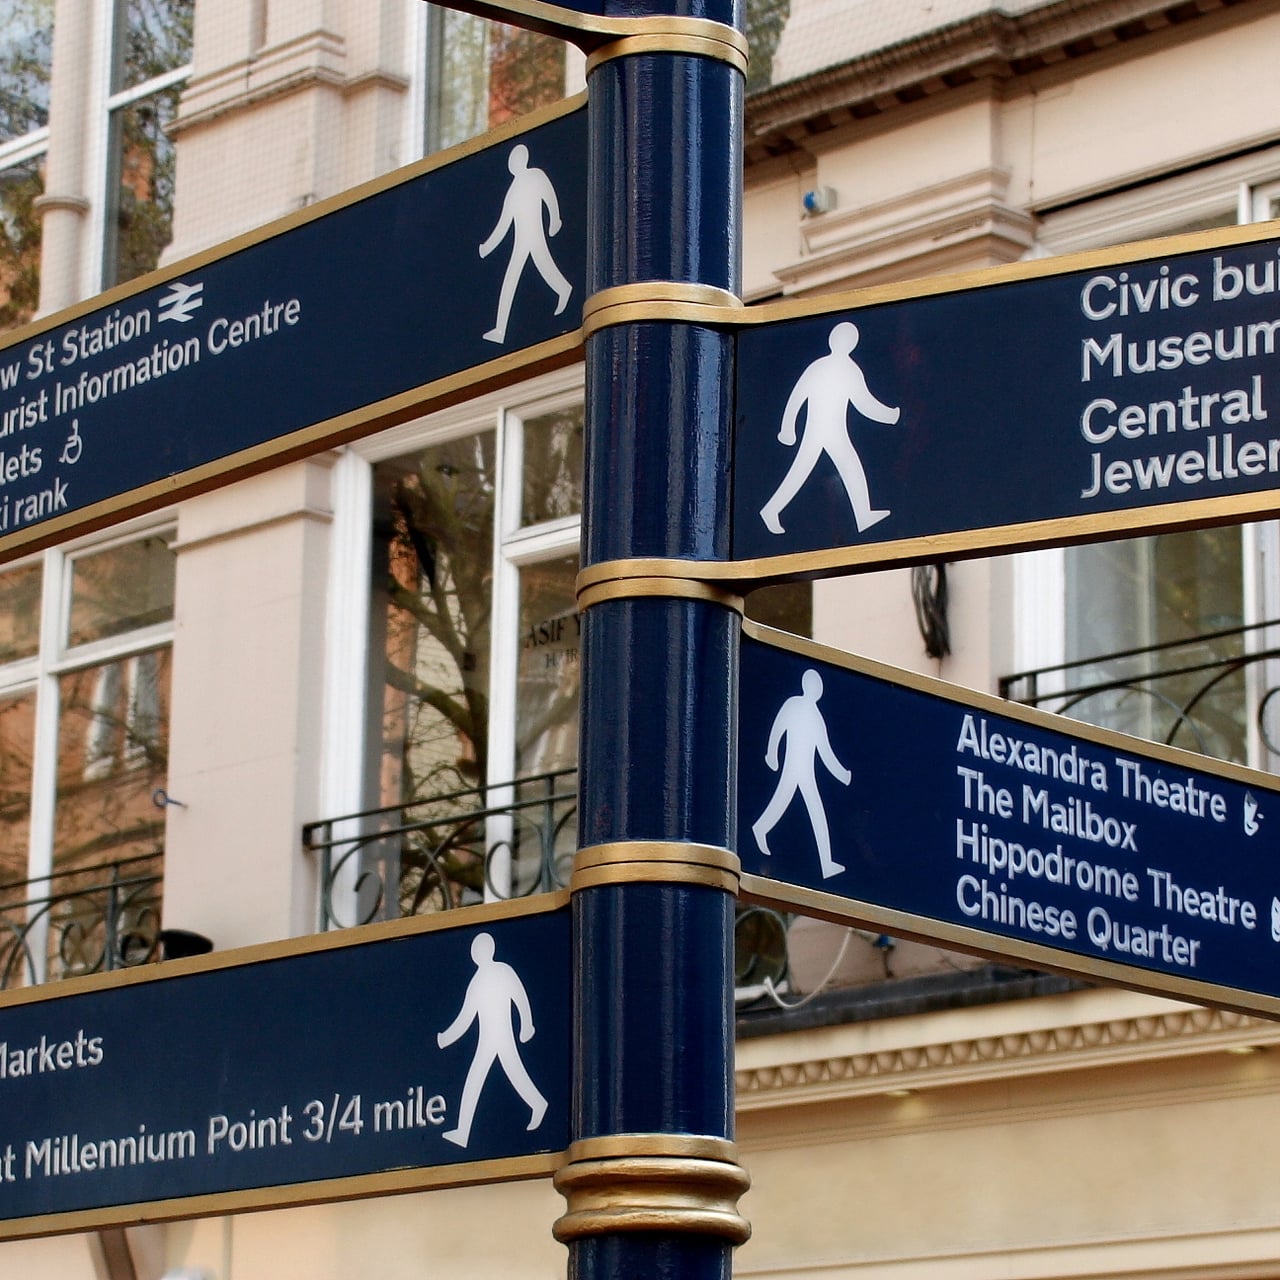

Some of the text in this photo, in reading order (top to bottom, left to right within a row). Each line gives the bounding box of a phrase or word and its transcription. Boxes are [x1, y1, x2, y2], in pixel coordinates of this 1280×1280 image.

[1081, 266, 1199, 322] Civic
[26, 342, 55, 380] St
[60, 308, 151, 367] Station
[54, 335, 200, 415] Information
[207, 296, 301, 356] Centre
[1081, 375, 1266, 444] Central
[14, 478, 68, 526] rank
[956, 715, 1226, 823] Alexandra Theatre
[956, 767, 1138, 853] The Mailbox
[956, 820, 1257, 930] Hippodrome Theatre
[956, 875, 1200, 968] Chinese Quarter
[24, 1129, 196, 1180] Millennium
[208, 1106, 292, 1155] Point
[302, 1093, 364, 1145] 3/4
[373, 1089, 446, 1134] mile
